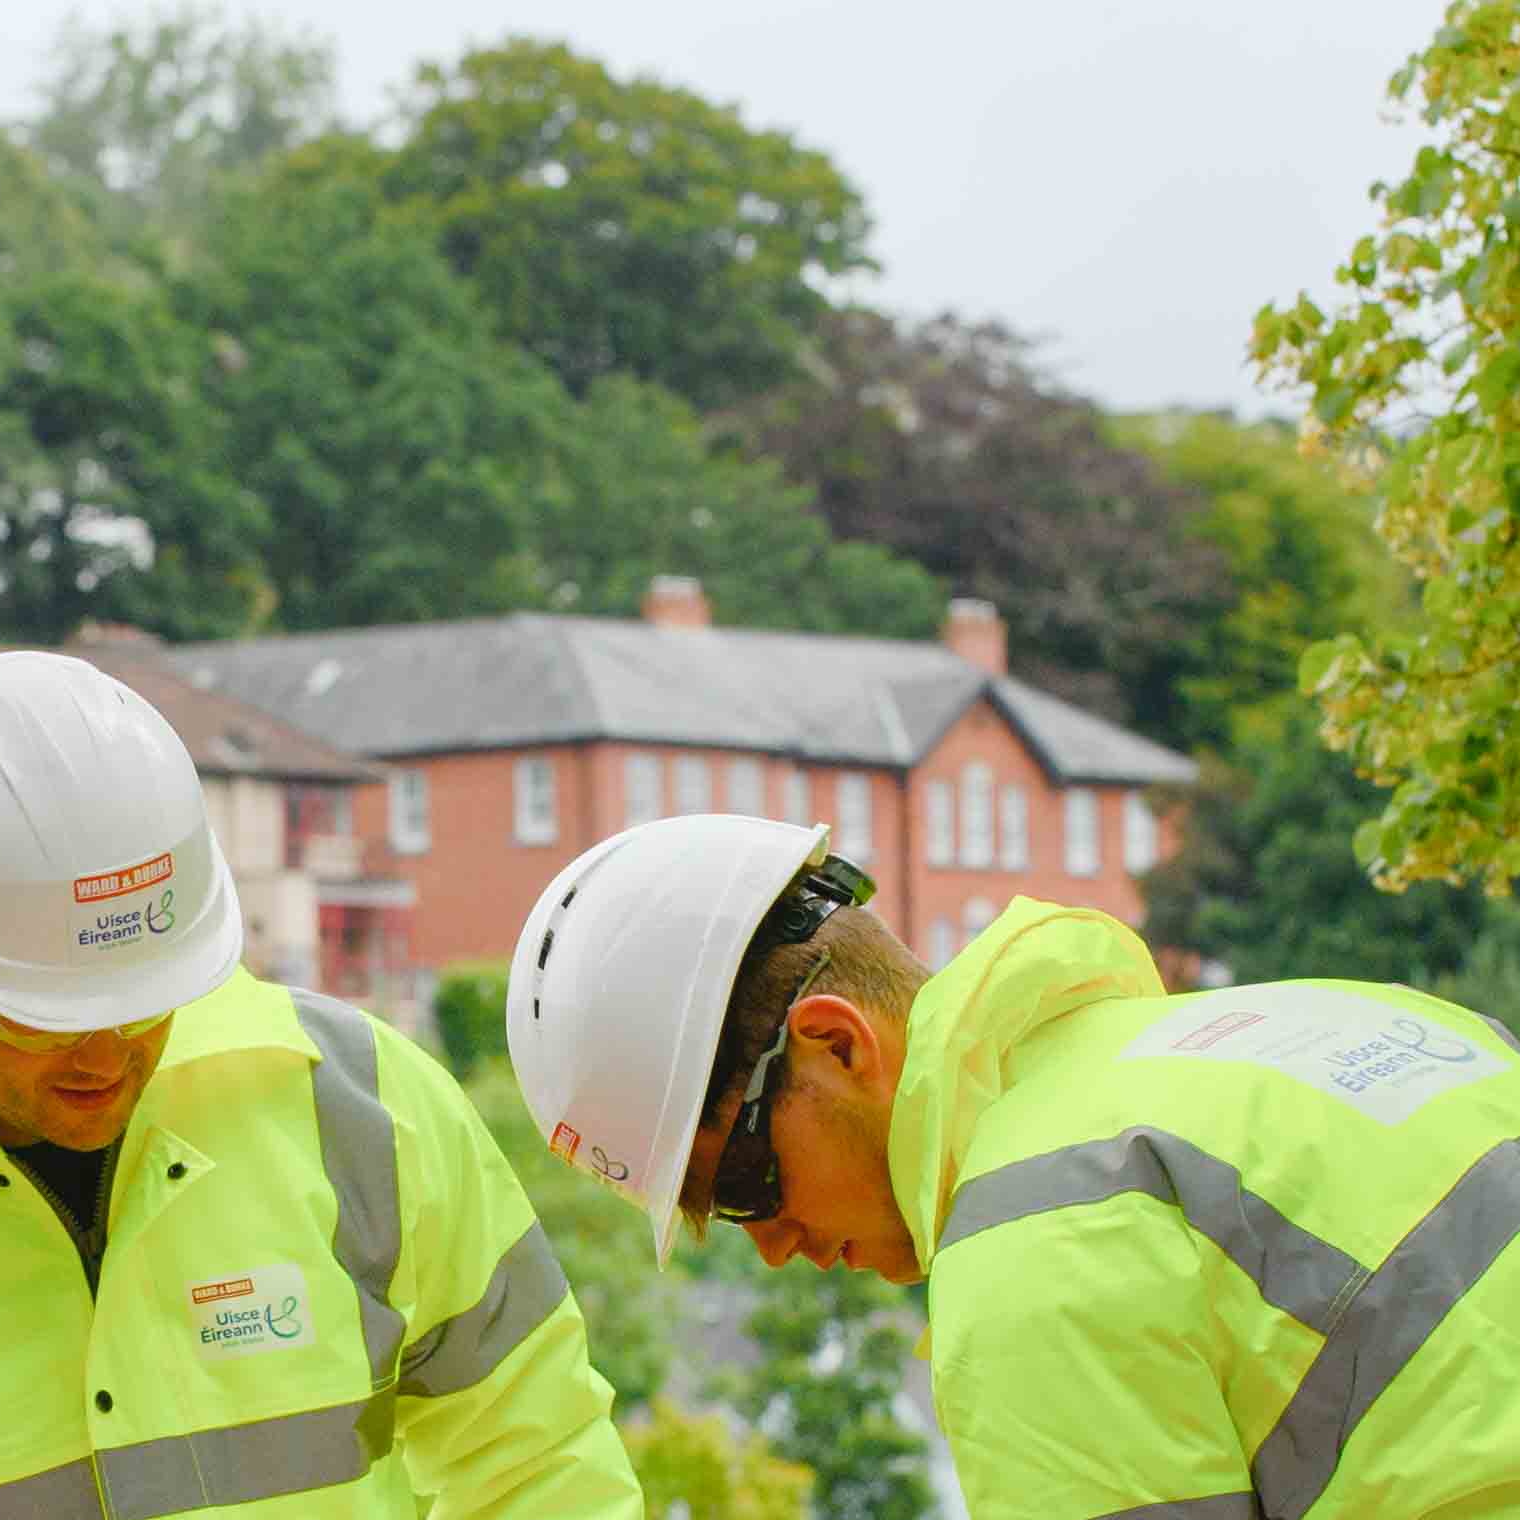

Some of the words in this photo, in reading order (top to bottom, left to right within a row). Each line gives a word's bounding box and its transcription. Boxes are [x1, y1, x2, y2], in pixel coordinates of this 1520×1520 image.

[97, 911, 141, 929] Uisce
[79, 924, 142, 945] Éireann
[216, 1309, 260, 1326] Uisce
[200, 1322, 264, 1344] Éireann
